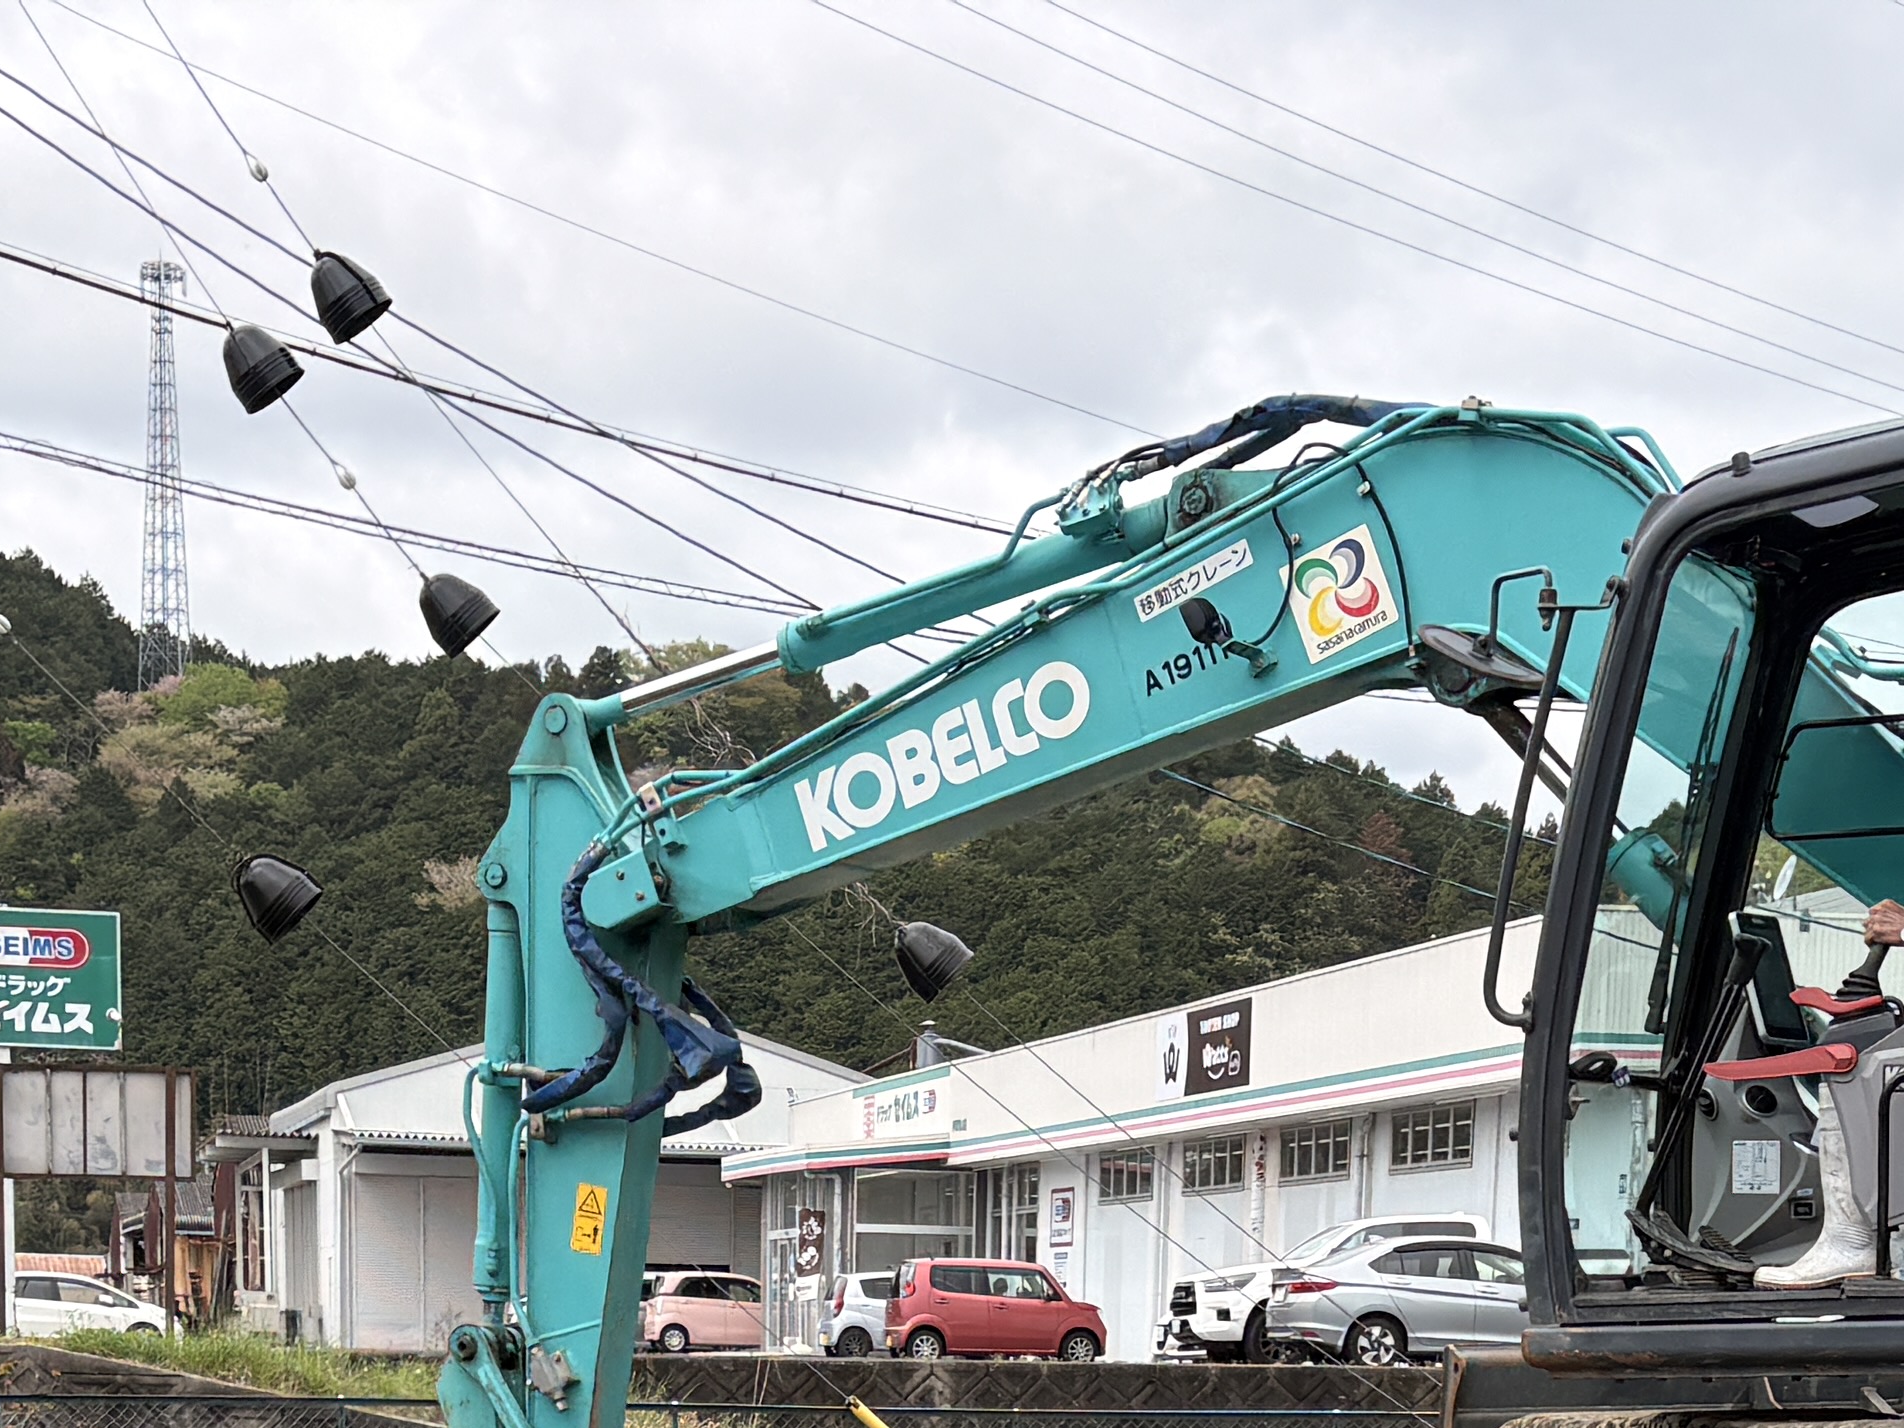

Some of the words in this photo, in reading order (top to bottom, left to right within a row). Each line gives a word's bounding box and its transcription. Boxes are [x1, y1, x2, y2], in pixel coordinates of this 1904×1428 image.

[1139, 547, 1248, 616] 移動式クレーン
[794, 661, 1090, 853] KOBELCO
